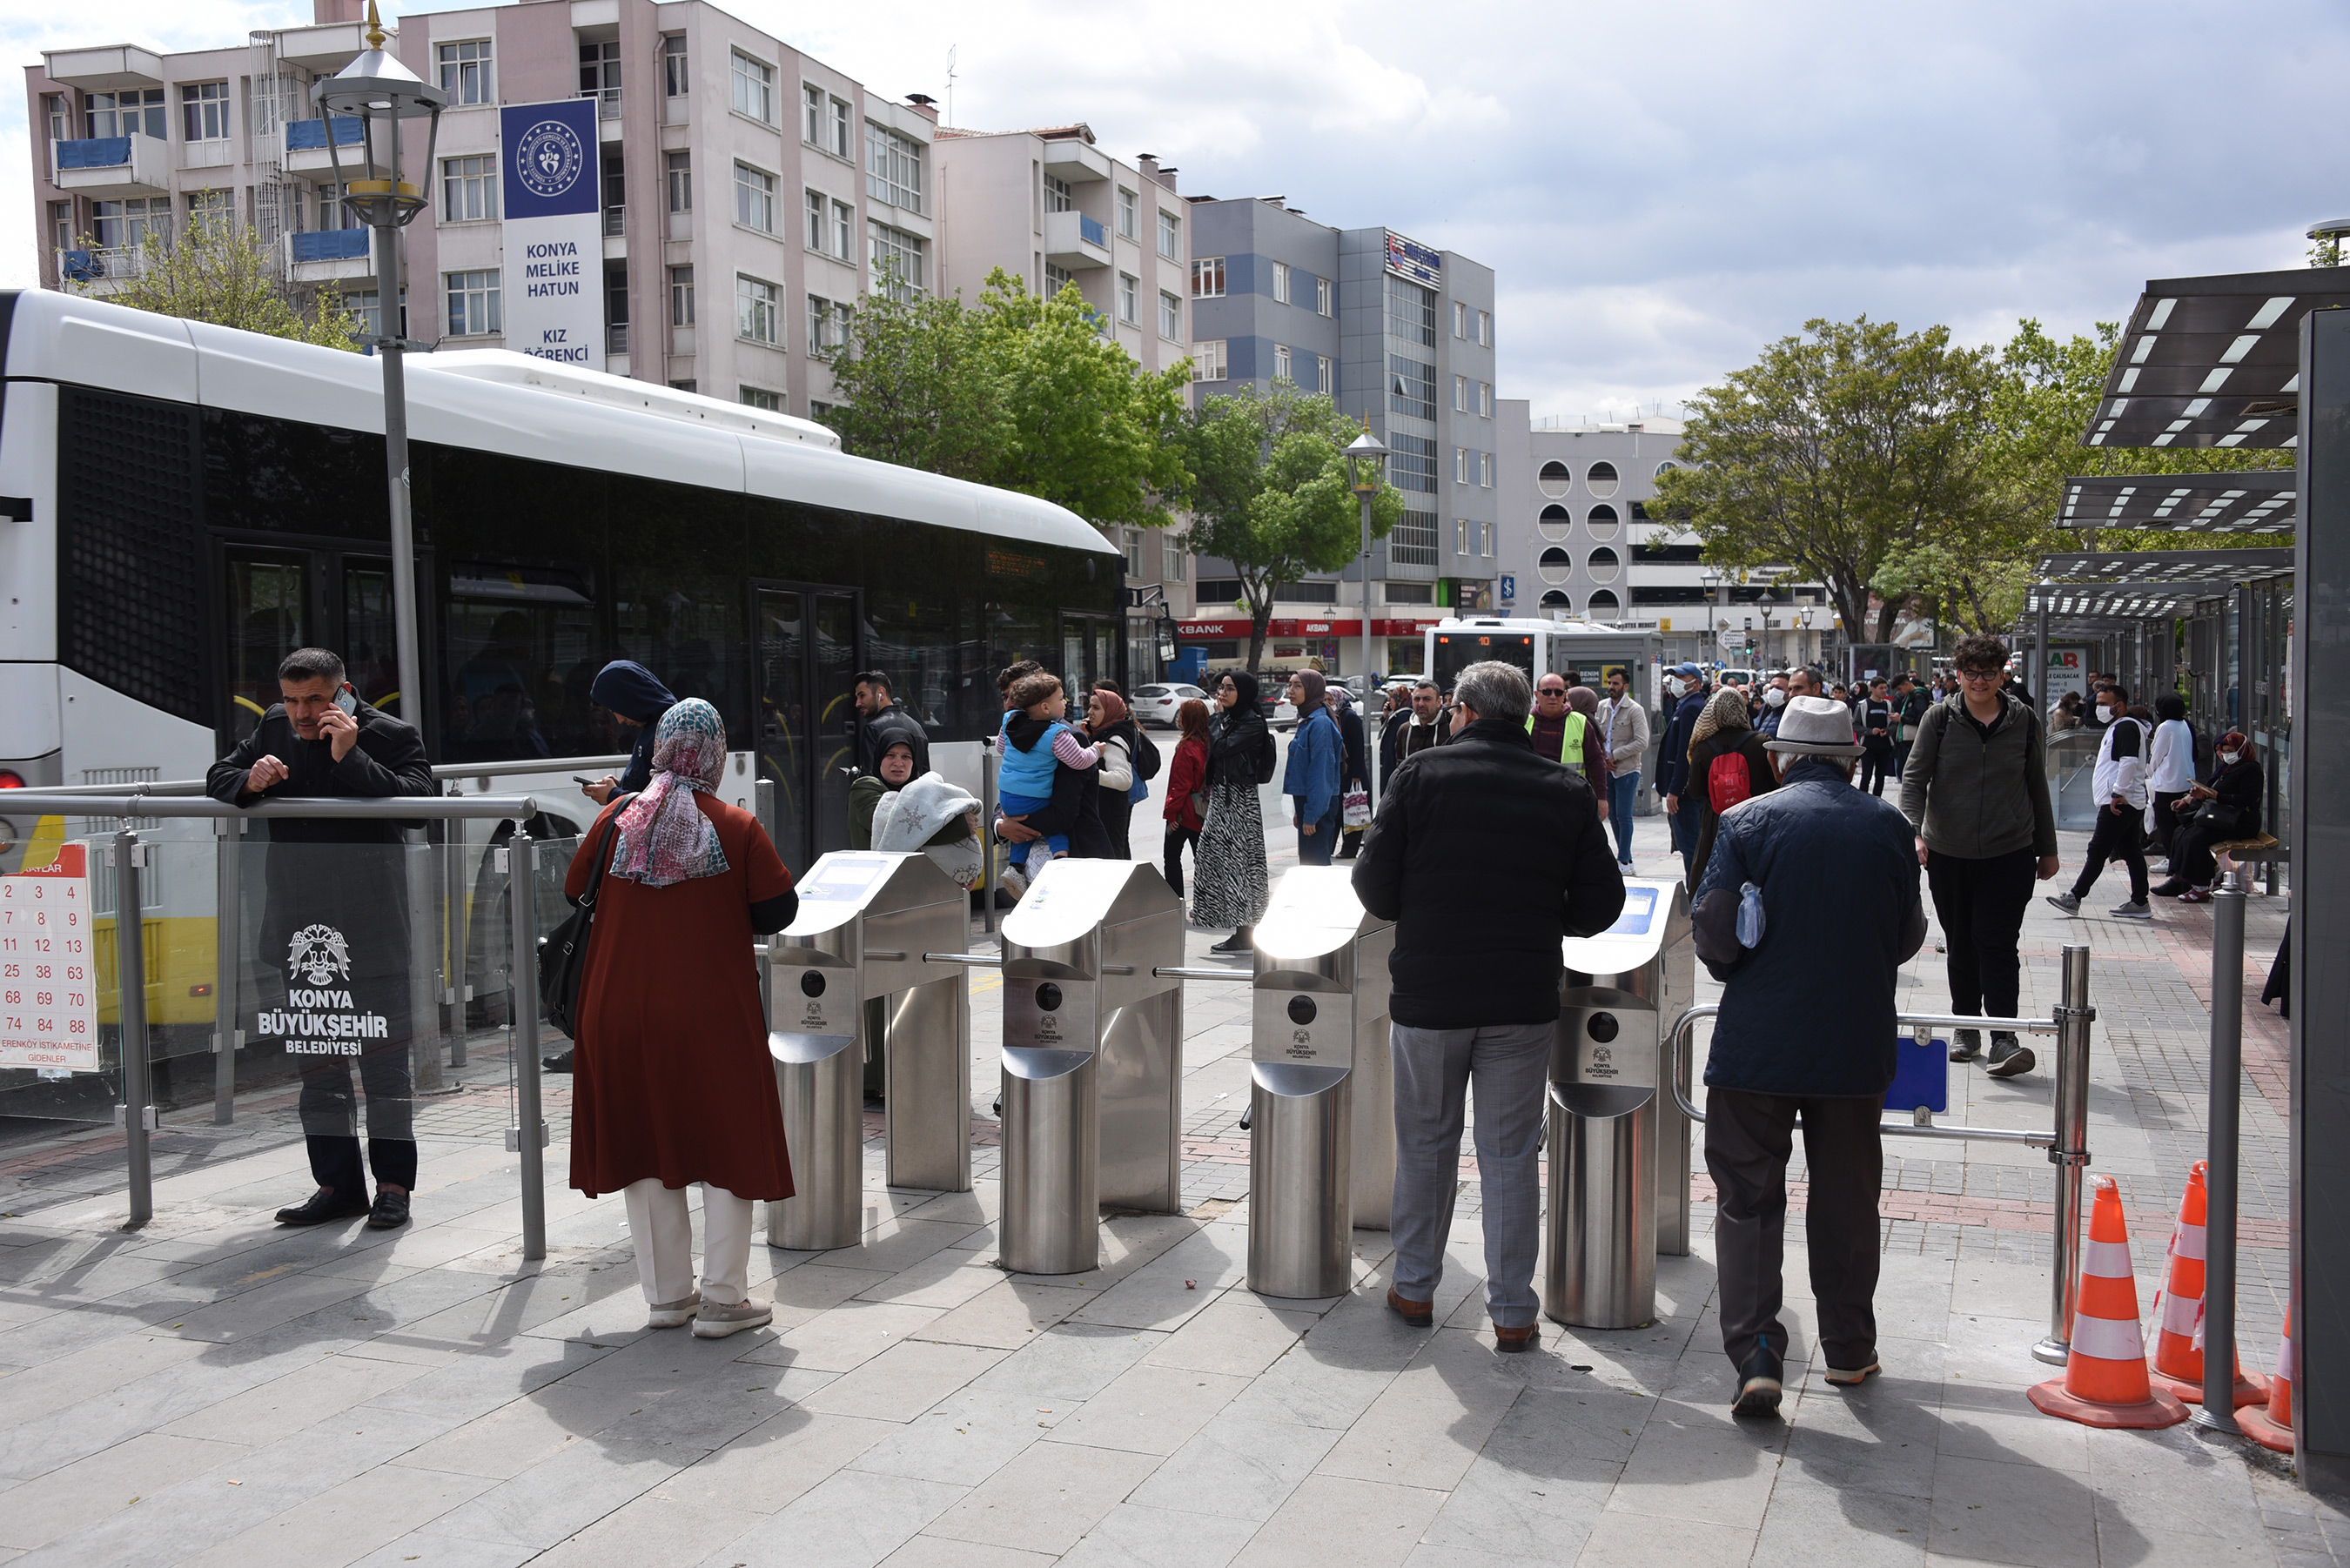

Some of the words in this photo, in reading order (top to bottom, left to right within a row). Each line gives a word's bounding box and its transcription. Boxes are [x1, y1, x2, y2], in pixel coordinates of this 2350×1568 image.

[527, 242, 577, 258] KONYA
[526, 259, 580, 278] MELİKE
[527, 281, 579, 298] HATUN
[543, 329, 567, 343] KIZ
[1479, 636, 1490, 646] 10
[2047, 653, 2078, 669] AR
[4, 884, 12, 898] 2
[35, 885, 43, 899] 3
[67, 886, 75, 899] 4
[5, 911, 13, 924] 7
[37, 912, 45, 925] 8
[69, 913, 77, 926] 9
[3, 938, 17, 951] 11
[35, 938, 50, 952] 12
[66, 939, 82, 953] 13
[4, 963, 20, 977] 25
[36, 965, 51, 979] 38
[67, 966, 84, 980] 63
[5, 990, 21, 1004] 68
[37, 991, 52, 1005] 69
[68, 993, 84, 1007] 70
[289, 989, 355, 1009] KONYA
[6, 1016, 22, 1030] 74
[37, 1018, 53, 1032] 84
[70, 1019, 85, 1034] 88
[258, 1008, 388, 1041] BÜYÜKŞEHİR
[2, 1038, 37, 1049] ERENKÖY
[39, 1039, 92, 1052] İSTİKAMETİNE
[285, 1038, 362, 1056] BELEDİYESİ
[28, 1053, 67, 1063] GİDENLER
